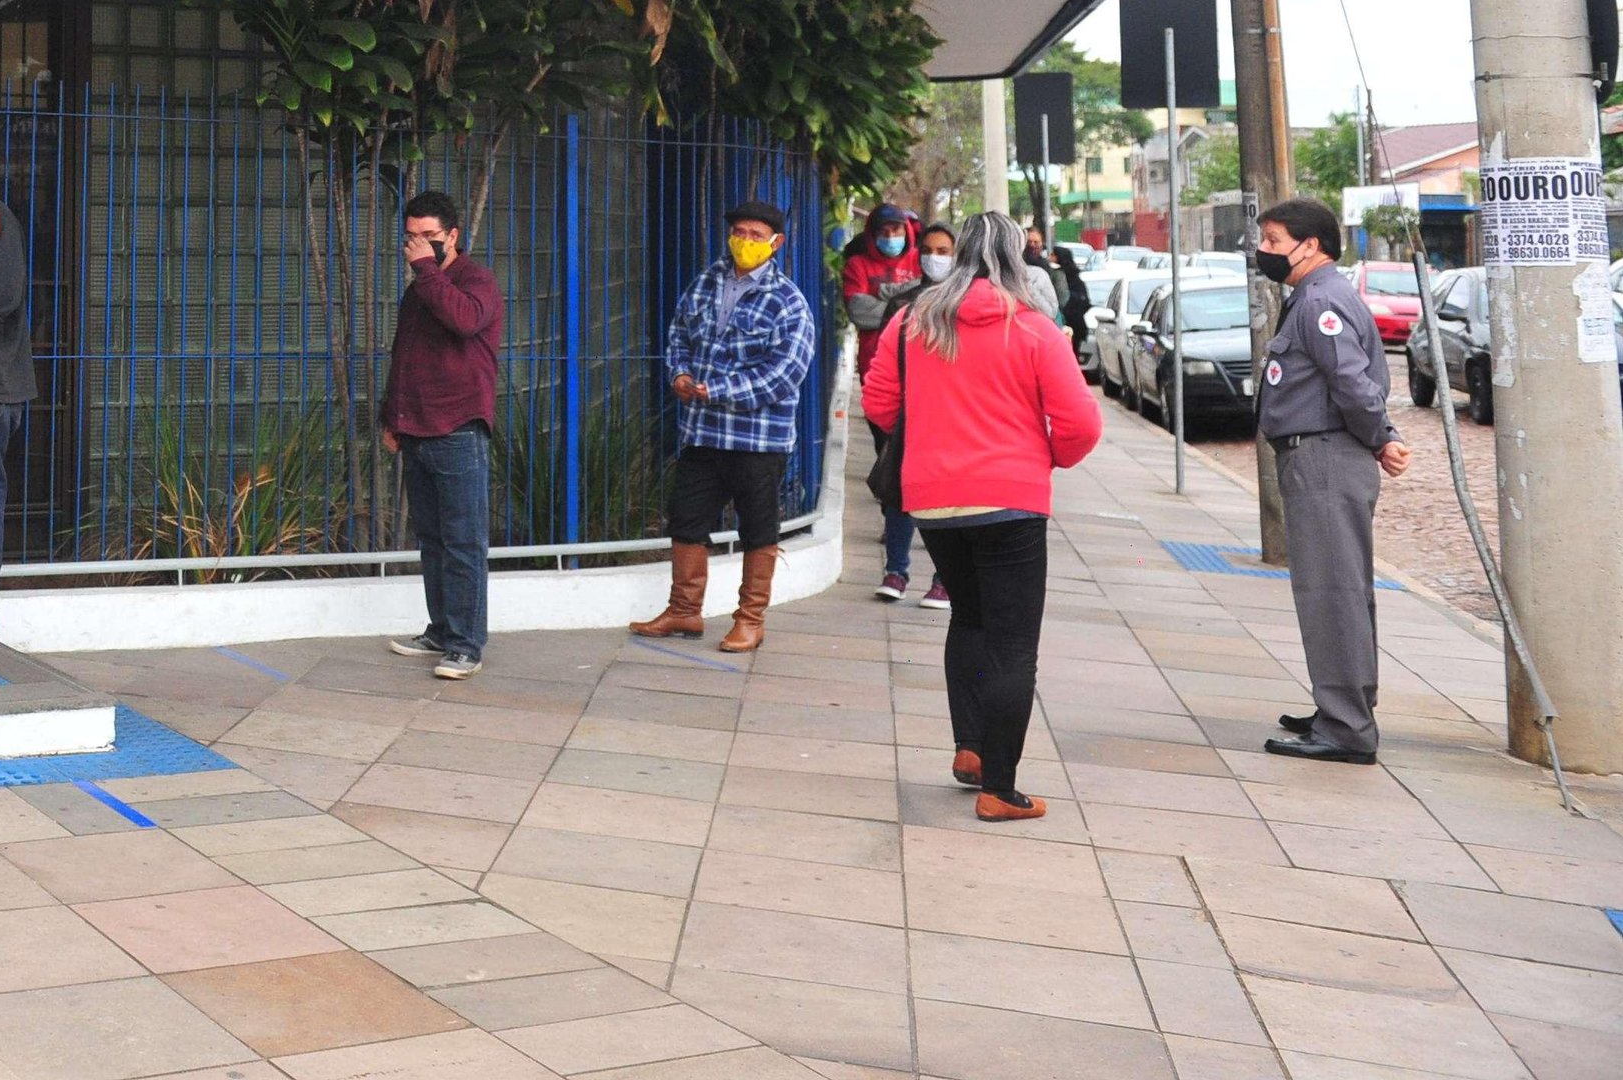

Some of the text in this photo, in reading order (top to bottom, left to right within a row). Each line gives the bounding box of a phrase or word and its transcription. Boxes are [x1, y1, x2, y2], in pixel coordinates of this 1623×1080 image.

[1498, 174, 1568, 201] OURO
[1570, 170, 1601, 197] OUR
[1507, 234, 1569, 246] 3374.4028
[1508, 247, 1570, 259] 98630.0664
